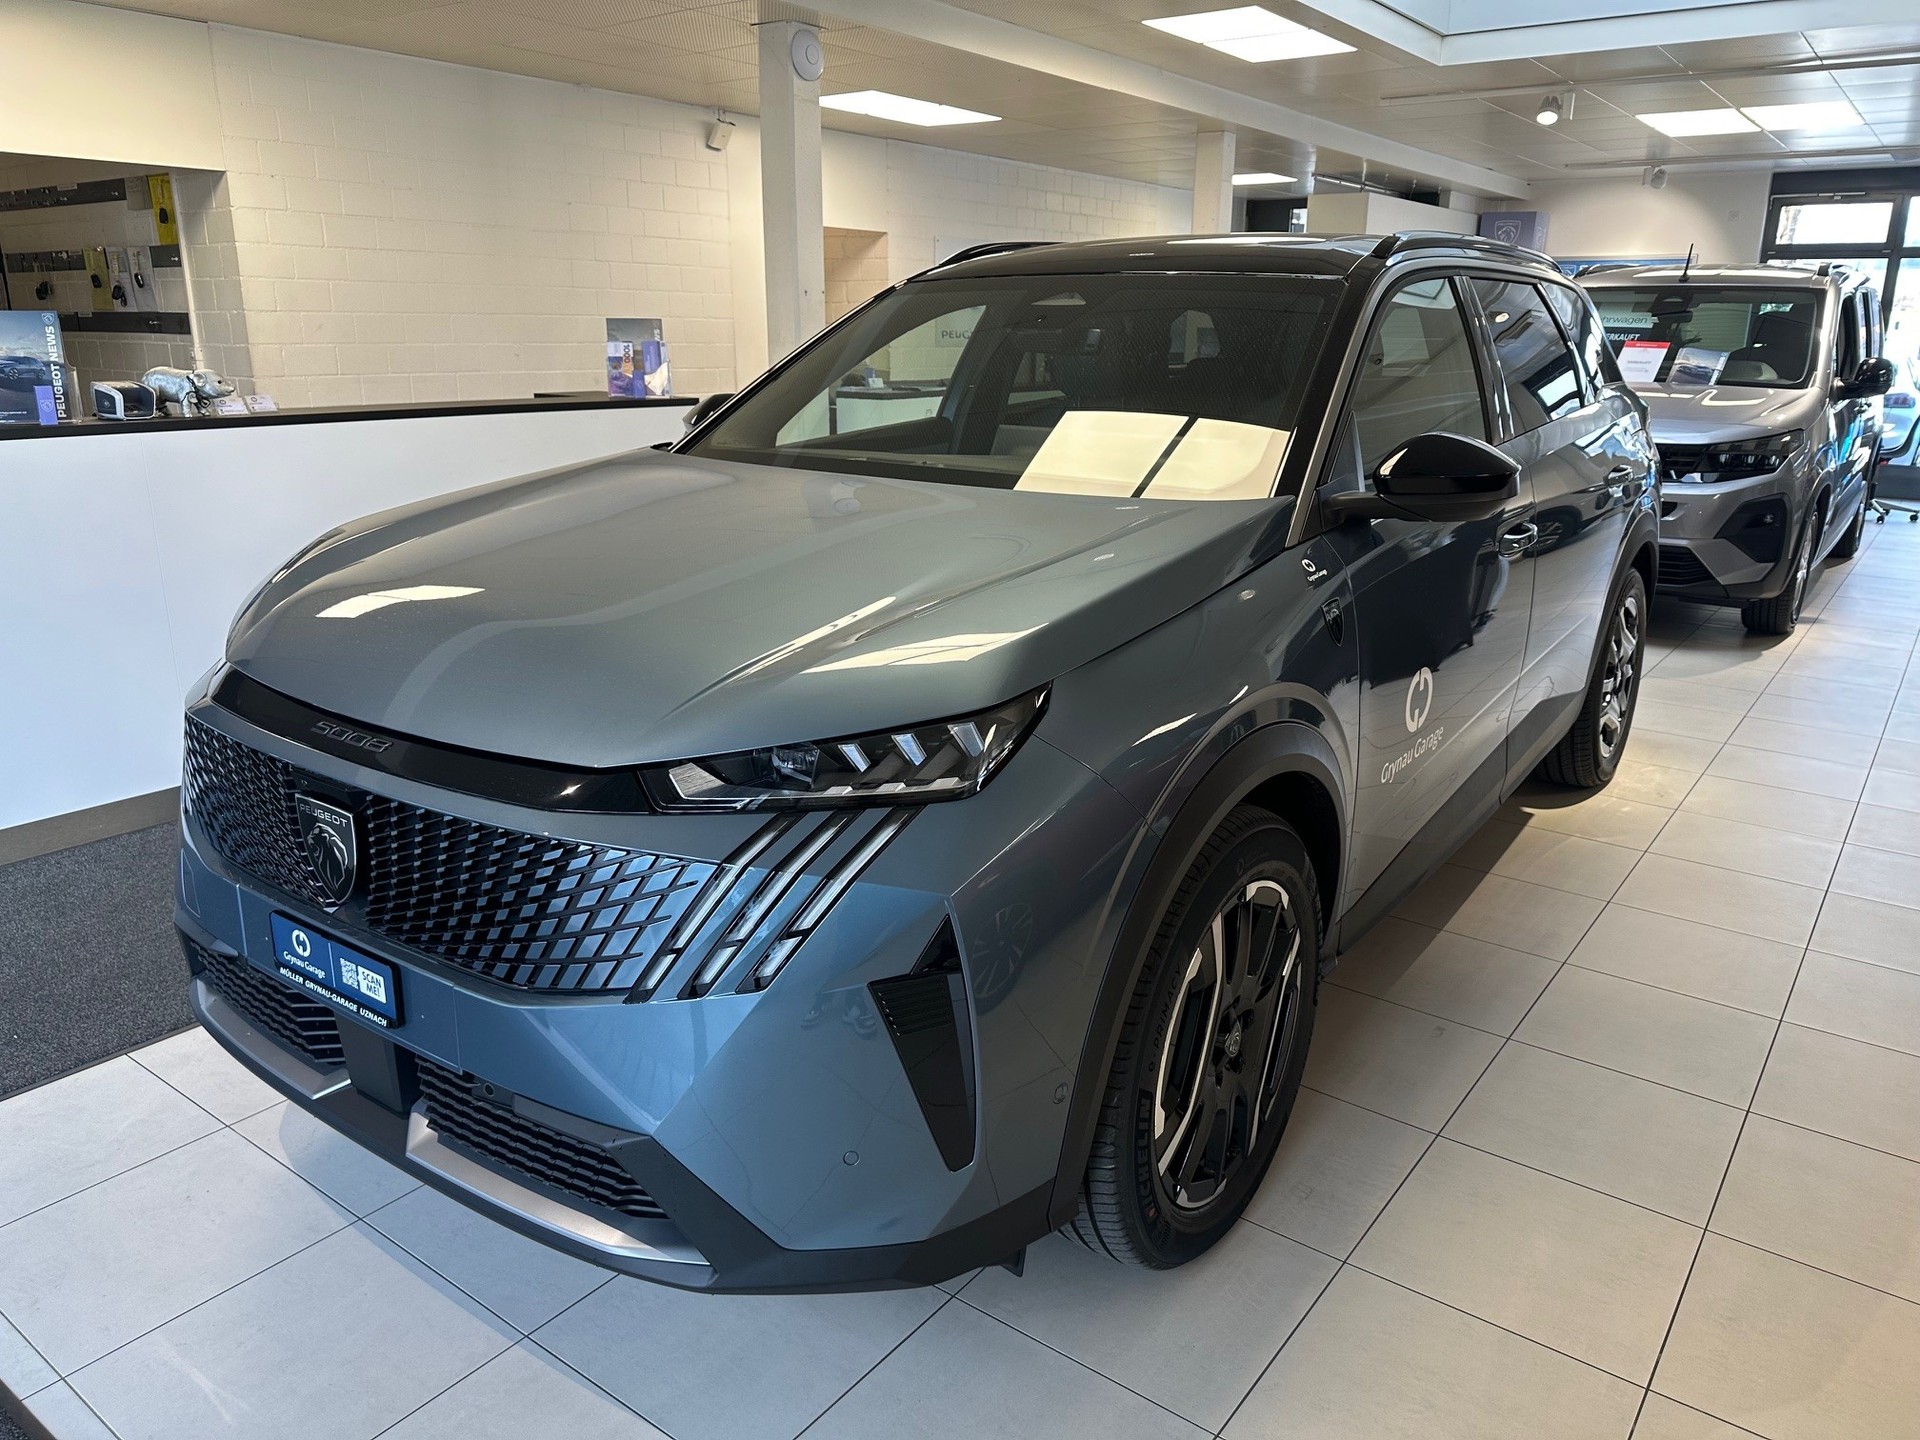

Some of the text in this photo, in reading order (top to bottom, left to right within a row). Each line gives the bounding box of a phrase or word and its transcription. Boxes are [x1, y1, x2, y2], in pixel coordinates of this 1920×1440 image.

[1602, 315, 1648, 325] hrwagen
[941, 330, 970, 339] PEUG
[1605, 333, 1640, 341] ERKAUFT
[623, 344, 632, 363] 1000
[45, 325, 67, 418] PEUGEOT NEWS
[310, 721, 393, 753] 5008
[1381, 726, 1444, 784] Grynau Garage
[300, 803, 348, 828] PEUGEOT
[283, 951, 326, 979] Grynau Garage
[362, 971, 382, 989] SCAN
[366, 983, 381, 998] ME!
[280, 966, 387, 1028] MÜLLER GRYNAU-GARAGE UZNACH
[1136, 1097, 1157, 1221] MICHELIN
